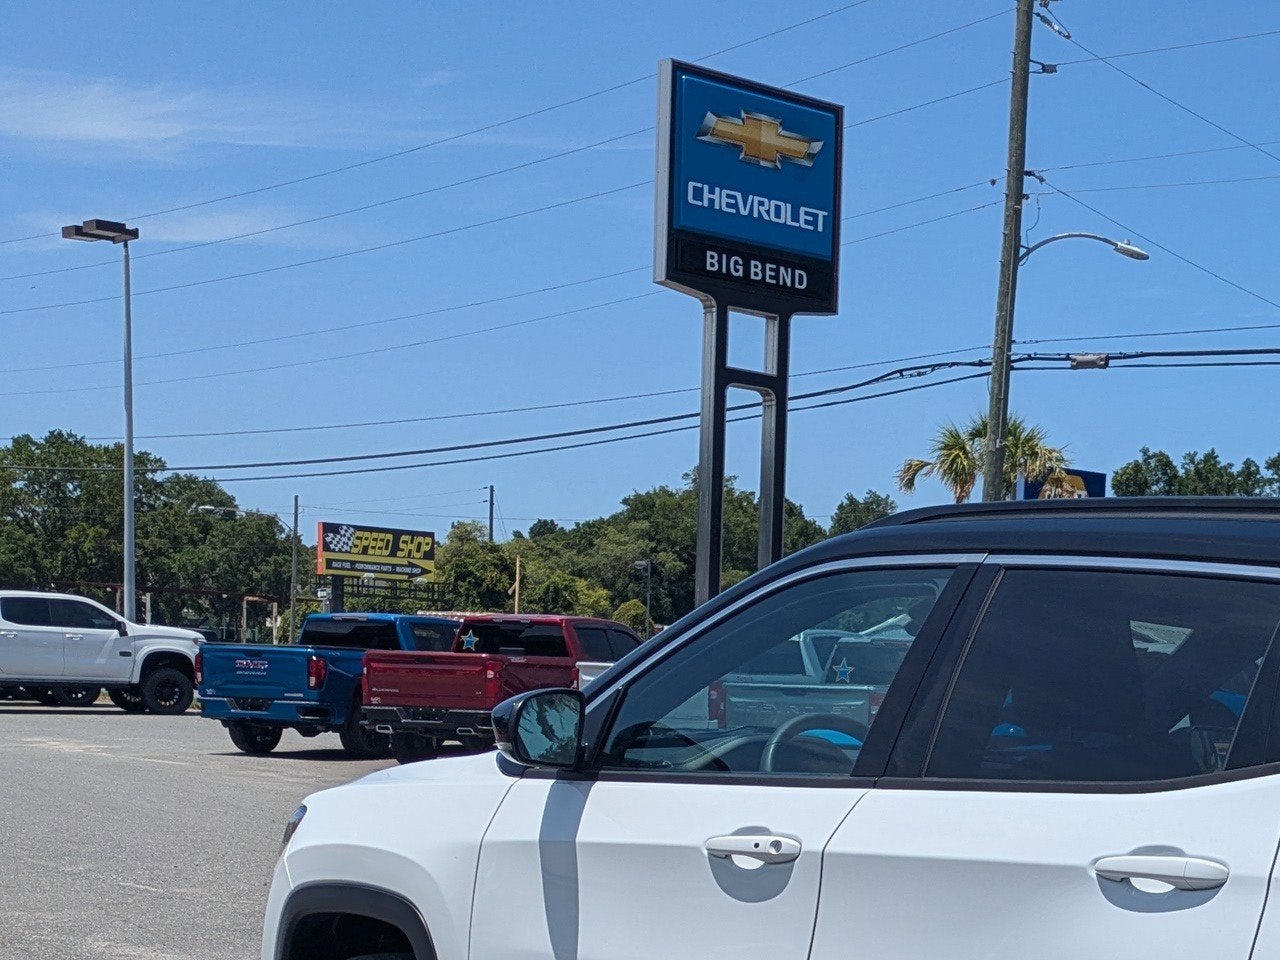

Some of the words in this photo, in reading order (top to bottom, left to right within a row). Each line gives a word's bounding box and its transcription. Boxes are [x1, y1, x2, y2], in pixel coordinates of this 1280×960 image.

[687, 181, 828, 233] CHEVROLET
[706, 250, 744, 277] BIG
[750, 259, 808, 290] BEND
[350, 530, 394, 556] SPEED
[396, 534, 432, 559] SHOP
